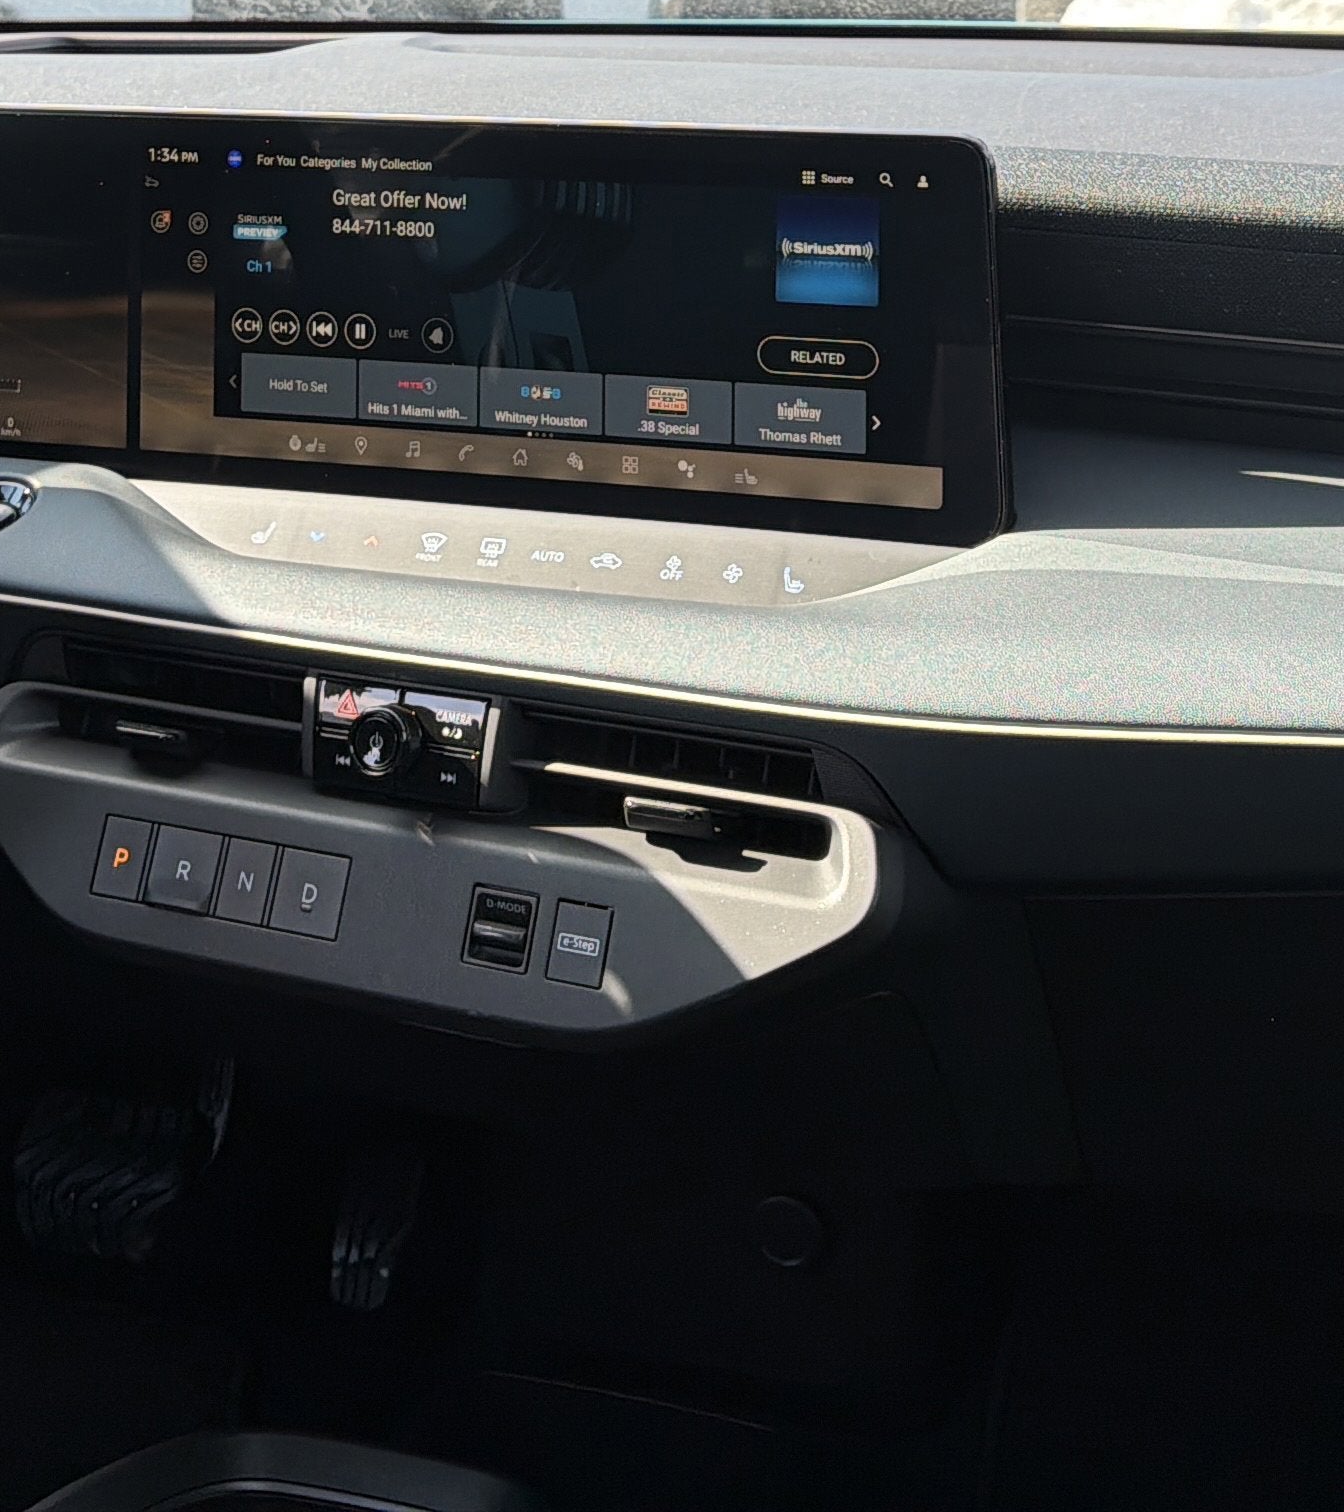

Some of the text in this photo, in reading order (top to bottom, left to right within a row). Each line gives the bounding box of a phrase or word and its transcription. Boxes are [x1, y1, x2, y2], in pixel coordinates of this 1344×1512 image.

[148, 148, 199, 163] 1:34 PM
[257, 155, 296, 167] For You
[300, 156, 356, 170] Categories
[362, 158, 432, 172] My Collection
[821, 174, 853, 185] Source
[333, 189, 467, 210] Great Offer Now!
[333, 219, 434, 237] 844-711-8800
[246, 260, 272, 272] Ch 1
[244, 320, 260, 333] CH
[271, 321, 287, 334] CH
[389, 328, 409, 339] LIVE
[790, 350, 845, 366] RELATED
[269, 379, 328, 393] Hold To Set
[651, 401, 686, 409] REWIND
[796, 398, 808, 408] the
[368, 403, 390, 414] Hits
[393, 404, 397, 415] 1
[401, 404, 434, 418] Miami
[777, 401, 822, 421] highway
[8, 418, 14, 428] 0
[495, 411, 587, 428] Whitney Houston
[1, 428, 21, 437] km/h
[637, 421, 700, 435] .38 Special
[759, 428, 842, 445] Thomas Rhett
[476, 558, 498, 568] REAR
[531, 550, 564, 563] AUTO
[660, 569, 683, 581] OFF
[436, 710, 473, 726] CAMERA
[113, 847, 129, 868] P
[176, 861, 191, 881] R
[238, 871, 254, 892] N
[301, 883, 317, 904] D
[486, 898, 526, 914] D-MODE
[563, 937, 594, 952] e-Step
